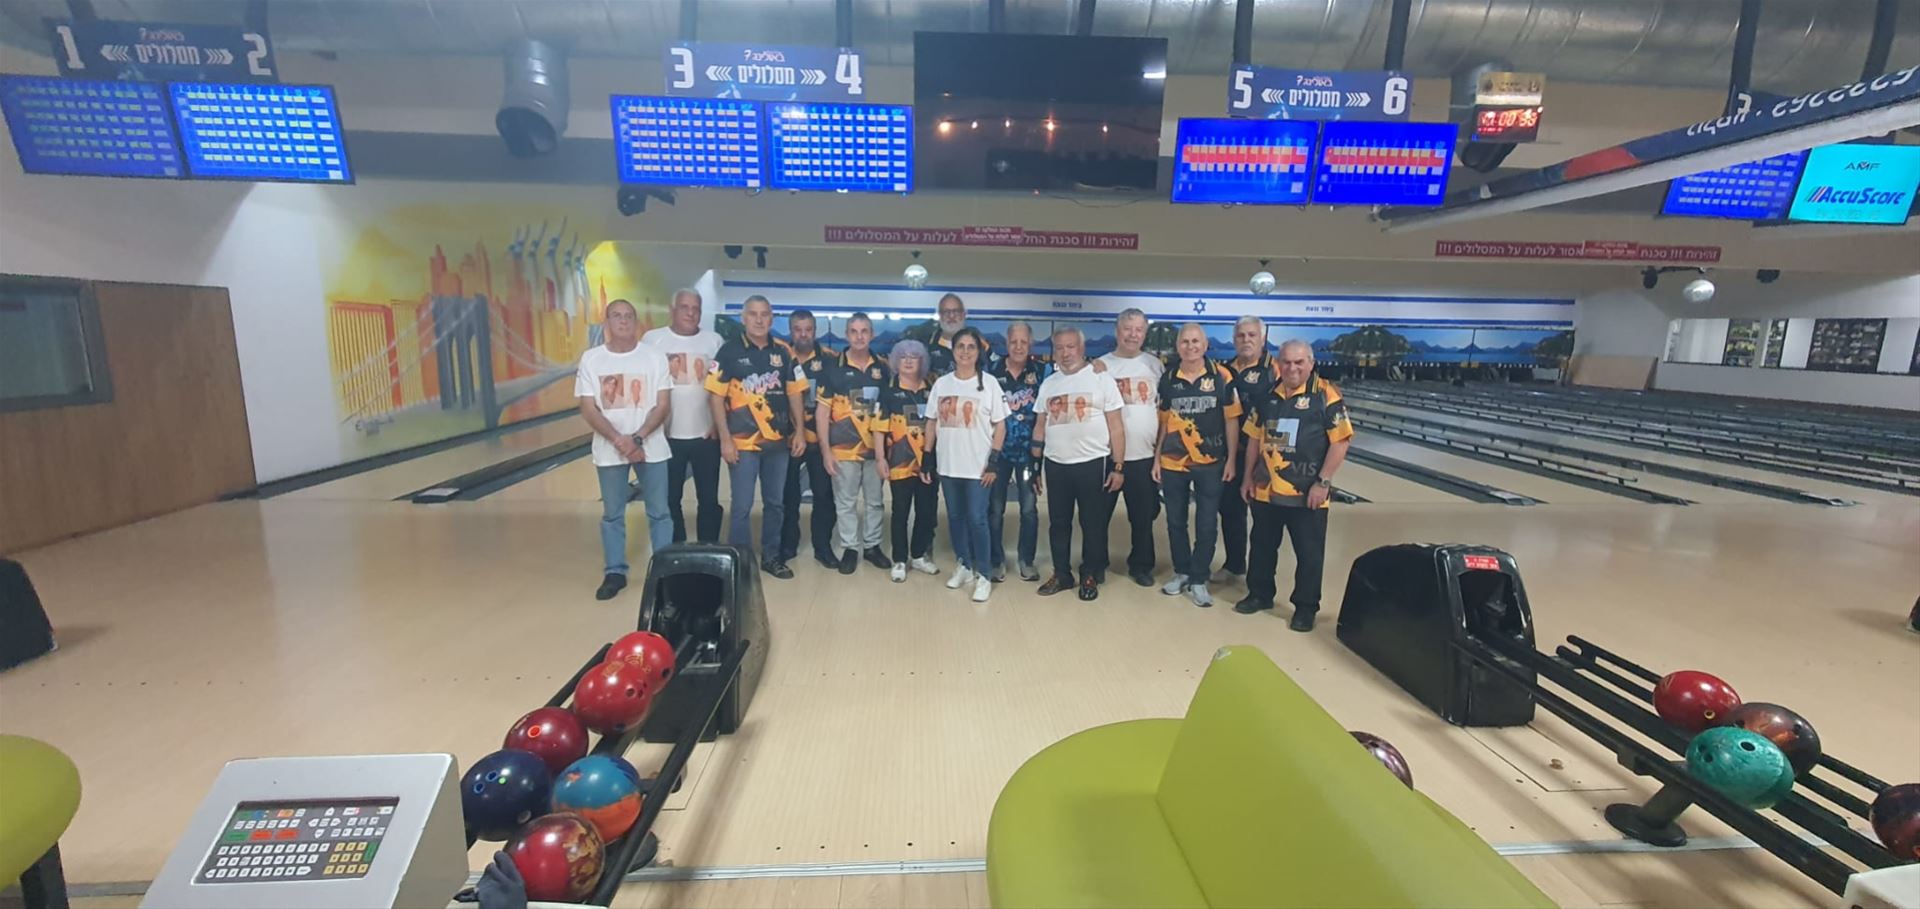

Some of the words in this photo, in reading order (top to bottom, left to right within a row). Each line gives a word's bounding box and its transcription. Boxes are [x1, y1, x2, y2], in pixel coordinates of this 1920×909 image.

[56, 25, 85, 69] 1
[134, 44, 200, 65] מסלולים
[243, 34, 272, 76] 2
[670, 47, 695, 88] 3
[737, 64, 796, 85] מסלולים
[835, 54, 862, 94] 4
[1233, 70, 1254, 109] 5
[1288, 88, 1341, 107] מסלולים
[1383, 77, 1408, 115] 6
[1844, 161, 1881, 171] AMF
[903, 230, 920, 241] על
[1019, 233, 1046, 245] החל
